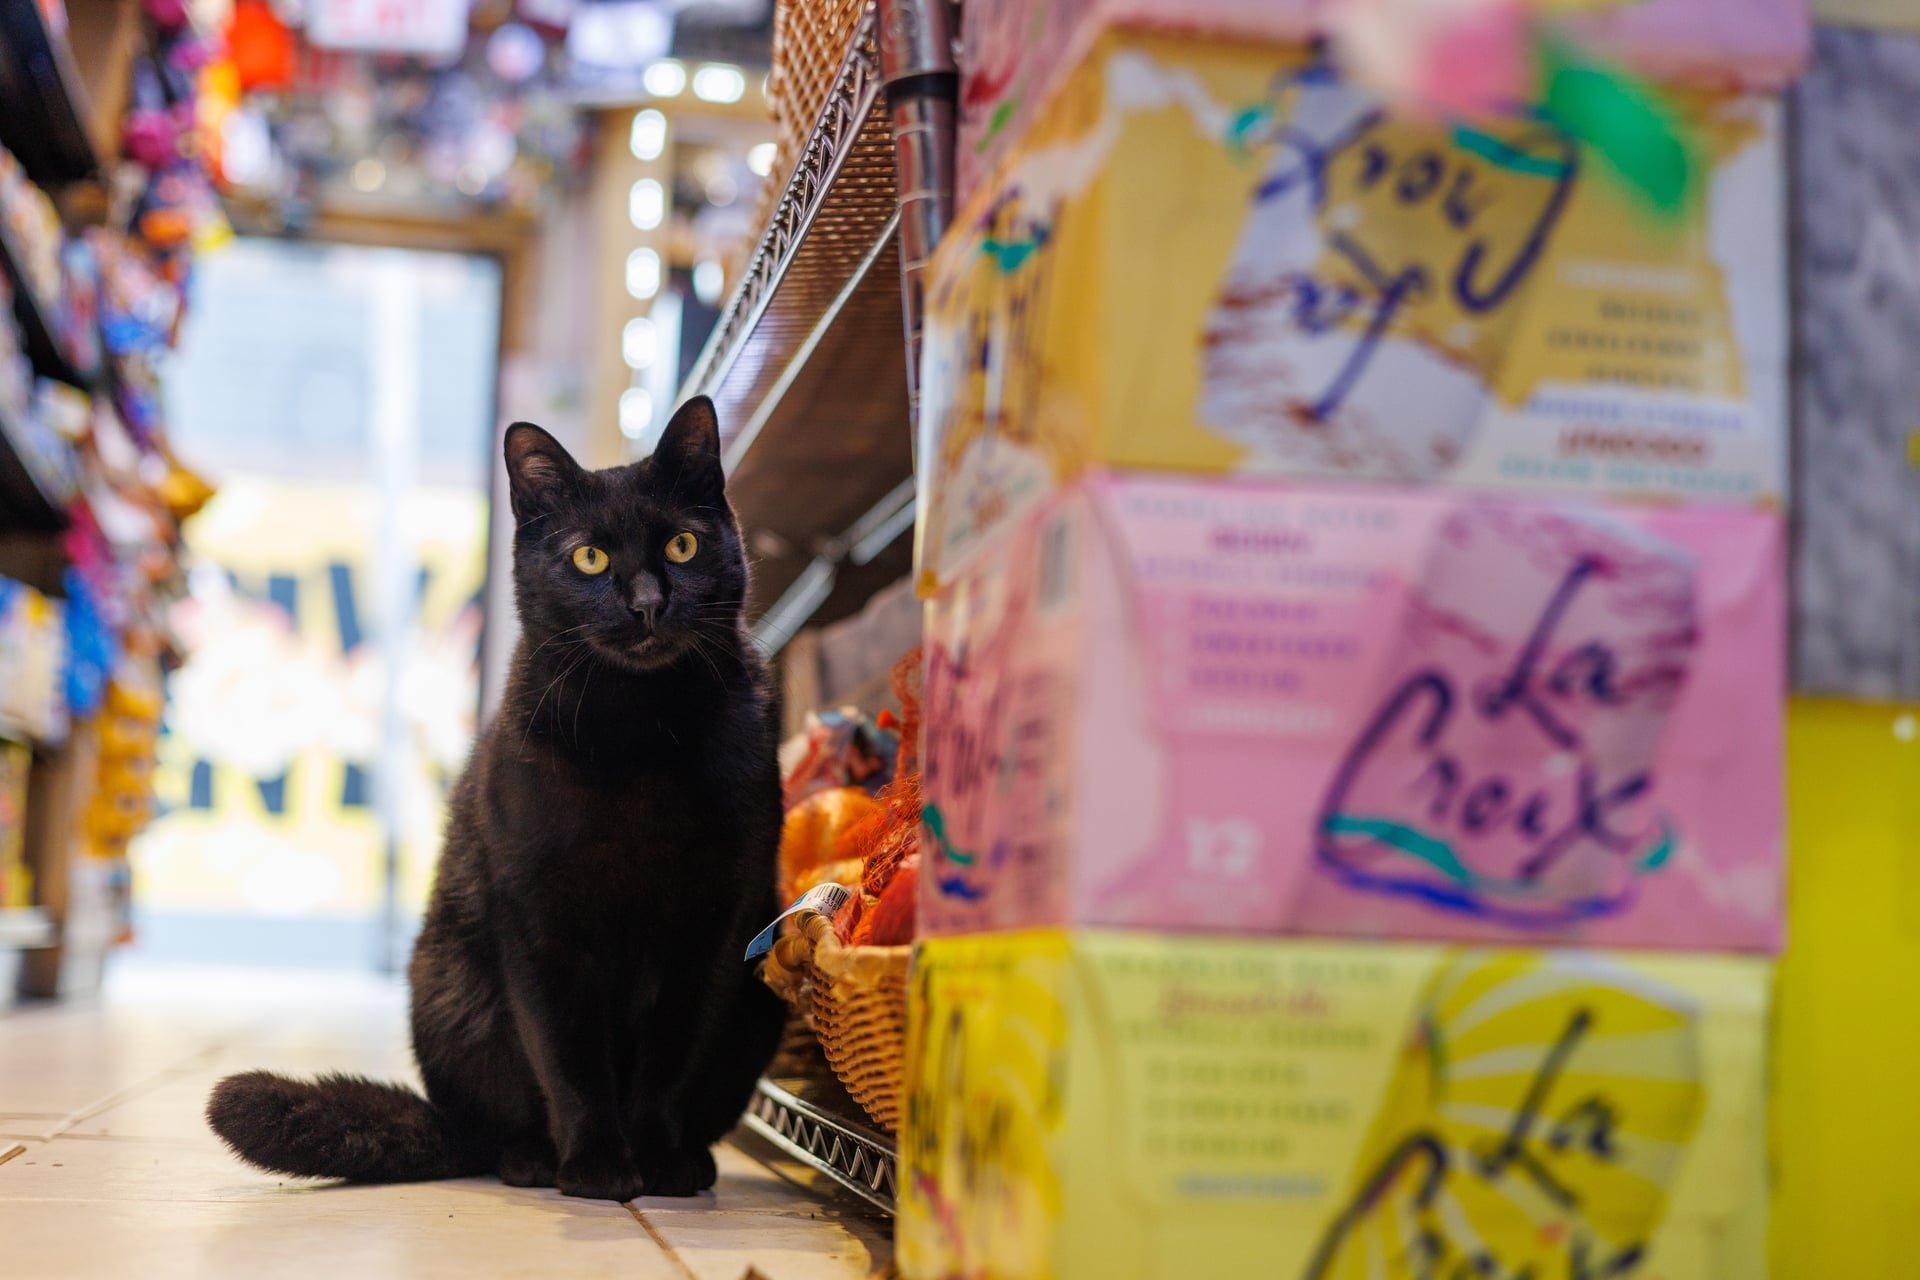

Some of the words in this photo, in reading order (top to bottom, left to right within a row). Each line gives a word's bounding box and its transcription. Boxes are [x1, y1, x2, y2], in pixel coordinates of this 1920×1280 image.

[1471, 555, 1626, 752] La
[1313, 668, 1654, 890] Croix
[1469, 1003, 1619, 1208] La
